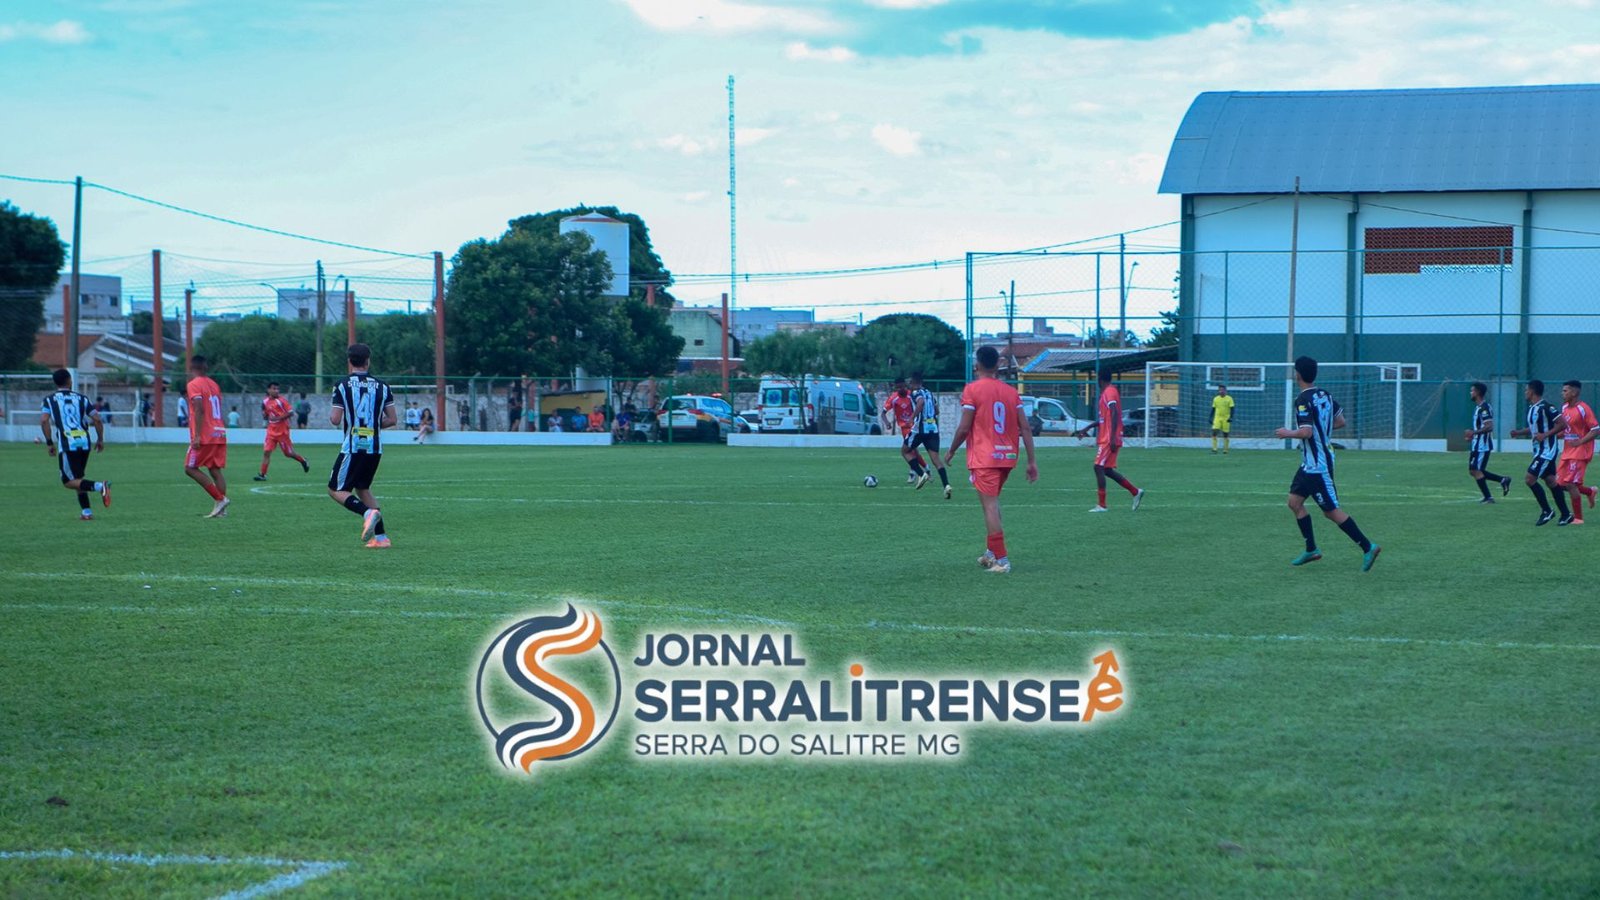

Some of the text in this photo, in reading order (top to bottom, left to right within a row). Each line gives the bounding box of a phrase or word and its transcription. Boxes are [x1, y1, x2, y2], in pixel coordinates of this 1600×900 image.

[63, 403, 79, 429] 8
[356, 392, 370, 425] 4
[993, 400, 1006, 435] 9
[1315, 492, 1325, 503] 3
